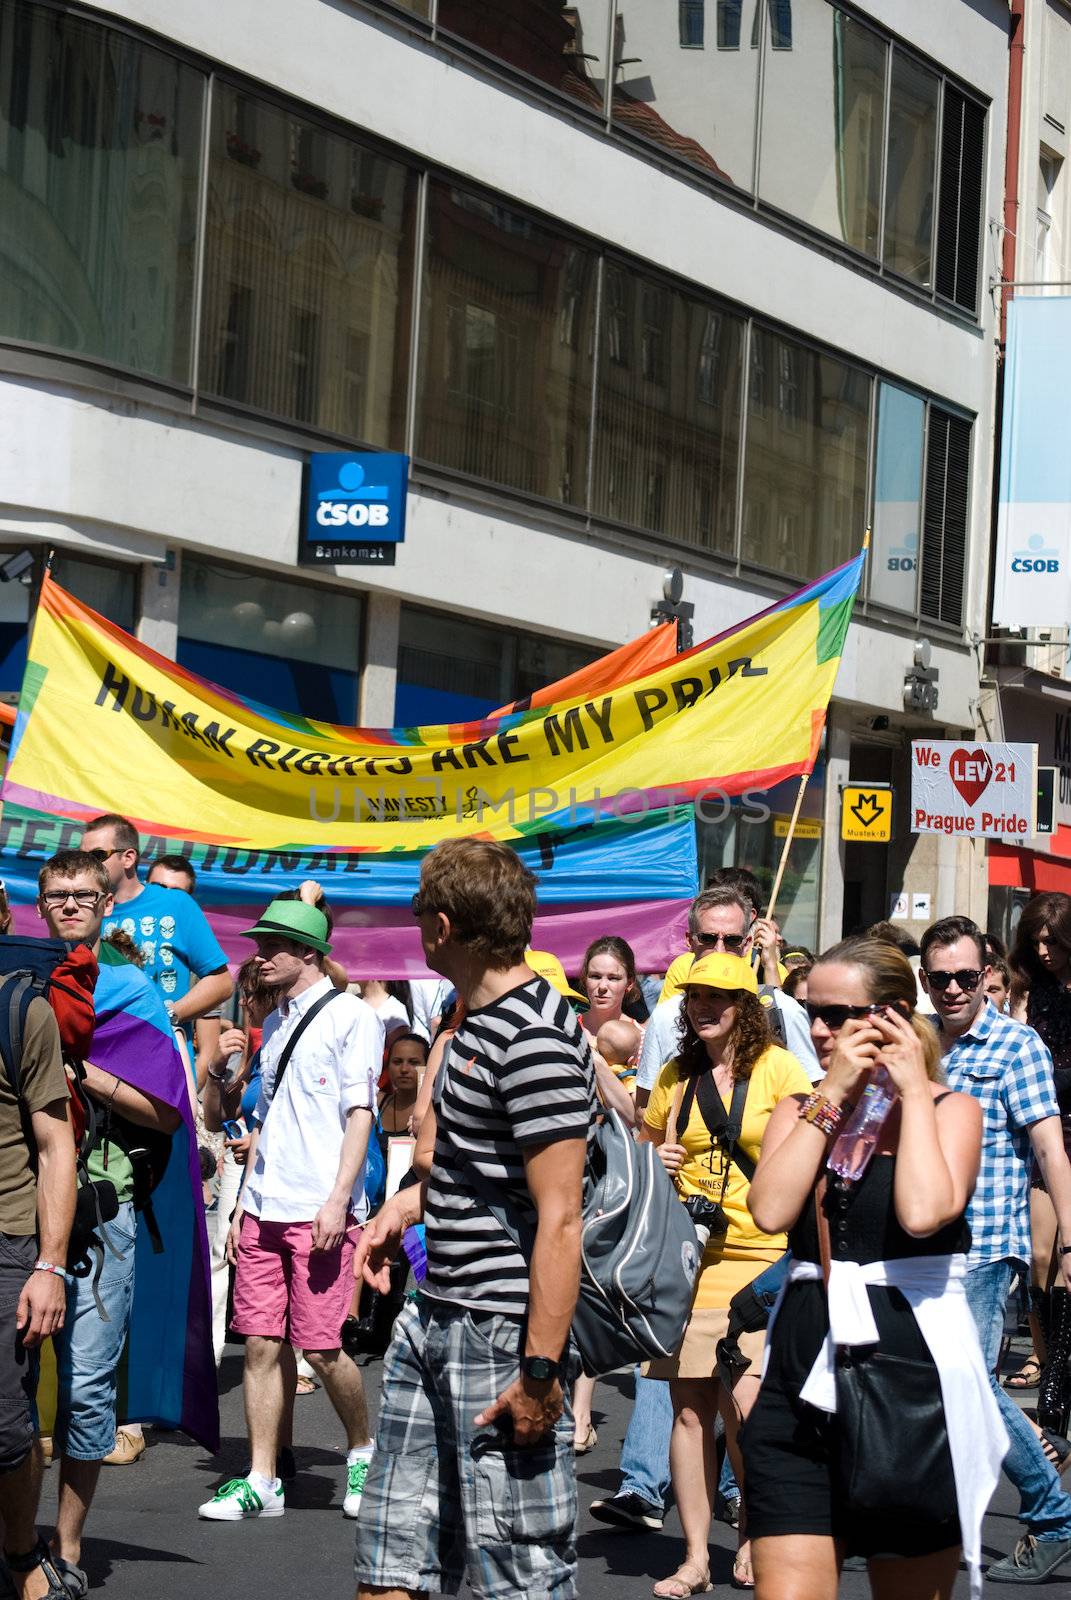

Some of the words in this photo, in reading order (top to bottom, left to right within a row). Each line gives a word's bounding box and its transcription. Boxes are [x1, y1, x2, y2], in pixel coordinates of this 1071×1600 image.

[316, 501, 389, 526] ČSOB
[316, 545, 384, 558] Bankomat
[1011, 558, 1059, 573] ČSOB
[432, 731, 530, 772] ARE
[543, 697, 615, 756] MY
[916, 747, 941, 766] We
[953, 761, 988, 782] LEV
[995, 762, 1016, 783] 21
[915, 809, 975, 834] Prague
[981, 812, 1028, 833] Pride
